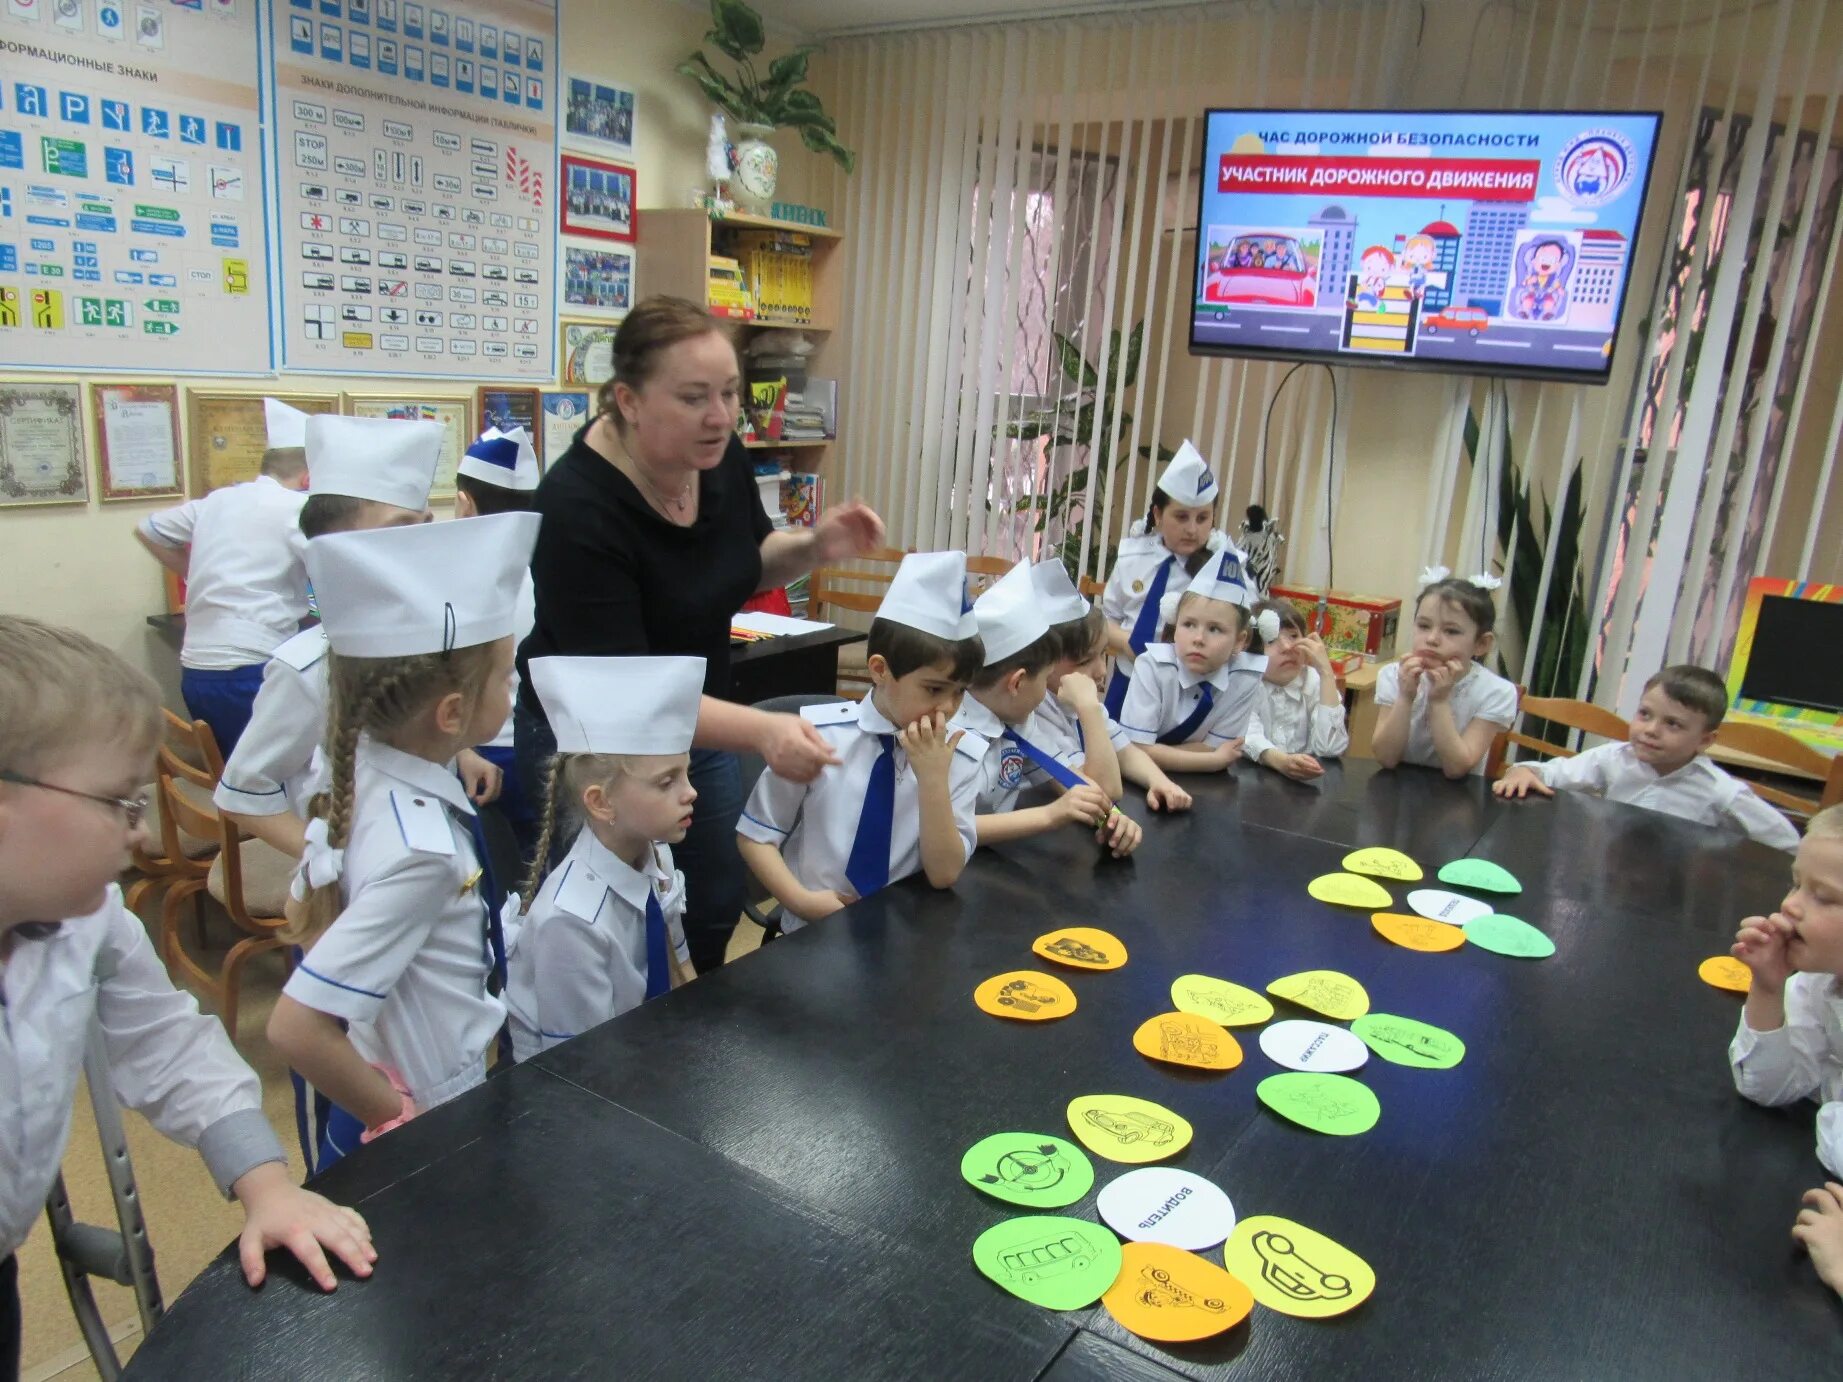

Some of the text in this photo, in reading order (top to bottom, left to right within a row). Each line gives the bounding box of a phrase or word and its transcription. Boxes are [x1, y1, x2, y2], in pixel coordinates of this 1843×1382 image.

[118, 65, 158, 83] ЗНАКИ
[301, 75, 334, 90] ЗНАКИ
[336, 82, 426, 110] ДОПОЛНИТЕЛЬНОЙ
[429, 103, 489, 125] ИНФОРМАЦИИ
[299, 137, 325, 150] STOP
[1259, 131, 1540, 147] ЧАС ДОРОЖНОЙ БЕЗОПАСНОСТИ
[1222, 166, 1535, 190] УЧАСТНИК ДОРОЖНОГО ДВИЖЕНИЯ
[191, 271, 211, 279] СТОП
[1138, 1186, 1194, 1230] ВОДИТЕЛЬ
